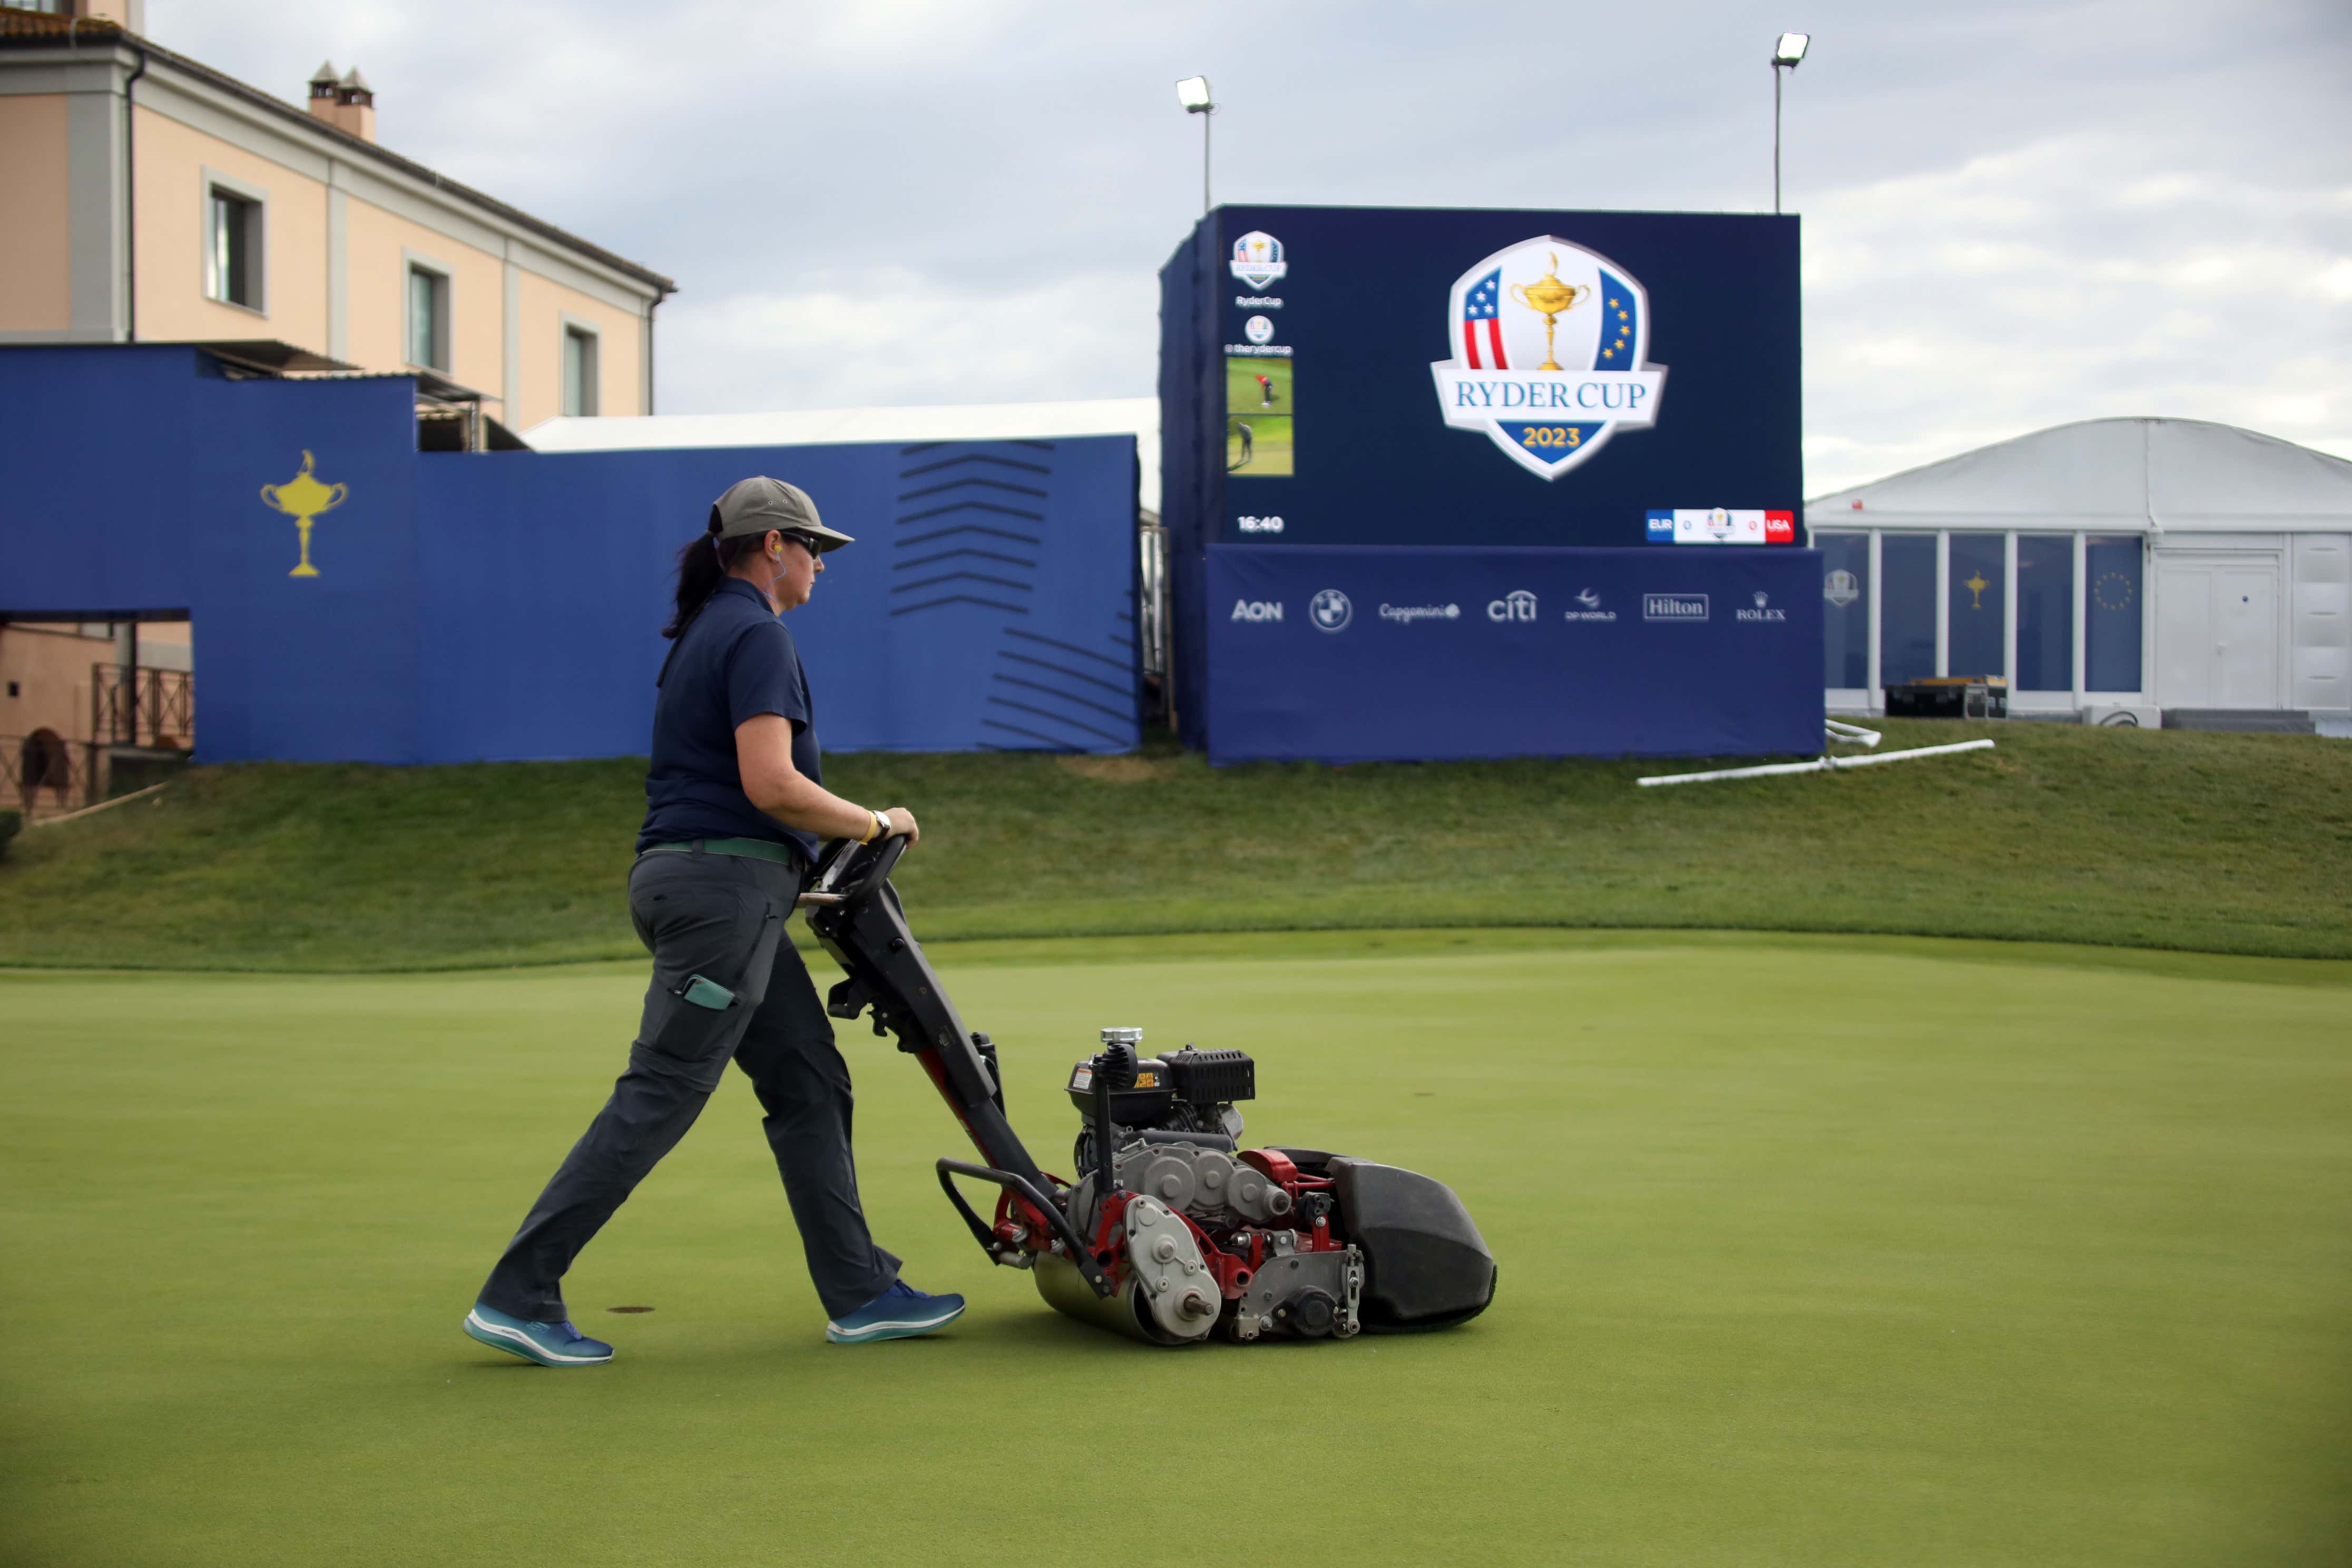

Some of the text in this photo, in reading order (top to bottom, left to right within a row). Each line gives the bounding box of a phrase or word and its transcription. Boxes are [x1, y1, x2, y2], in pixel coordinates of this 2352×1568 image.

[1237, 296, 1282, 308] RyderCup
[1455, 380, 1647, 409] RYDER CUP
[1522, 427, 1581, 447] 2023
[1238, 516, 1284, 533] 16:40
[1648, 518, 1673, 531] EUR
[1766, 519, 1791, 531] USA
[1231, 599, 1283, 621] AON
[1379, 603, 1445, 624] Capgemini
[1487, 591, 1537, 621] citi
[1648, 598, 1703, 614] Hilton
[1581, 611, 1616, 620] WORLD
[1737, 609, 1786, 621] ROLEX
